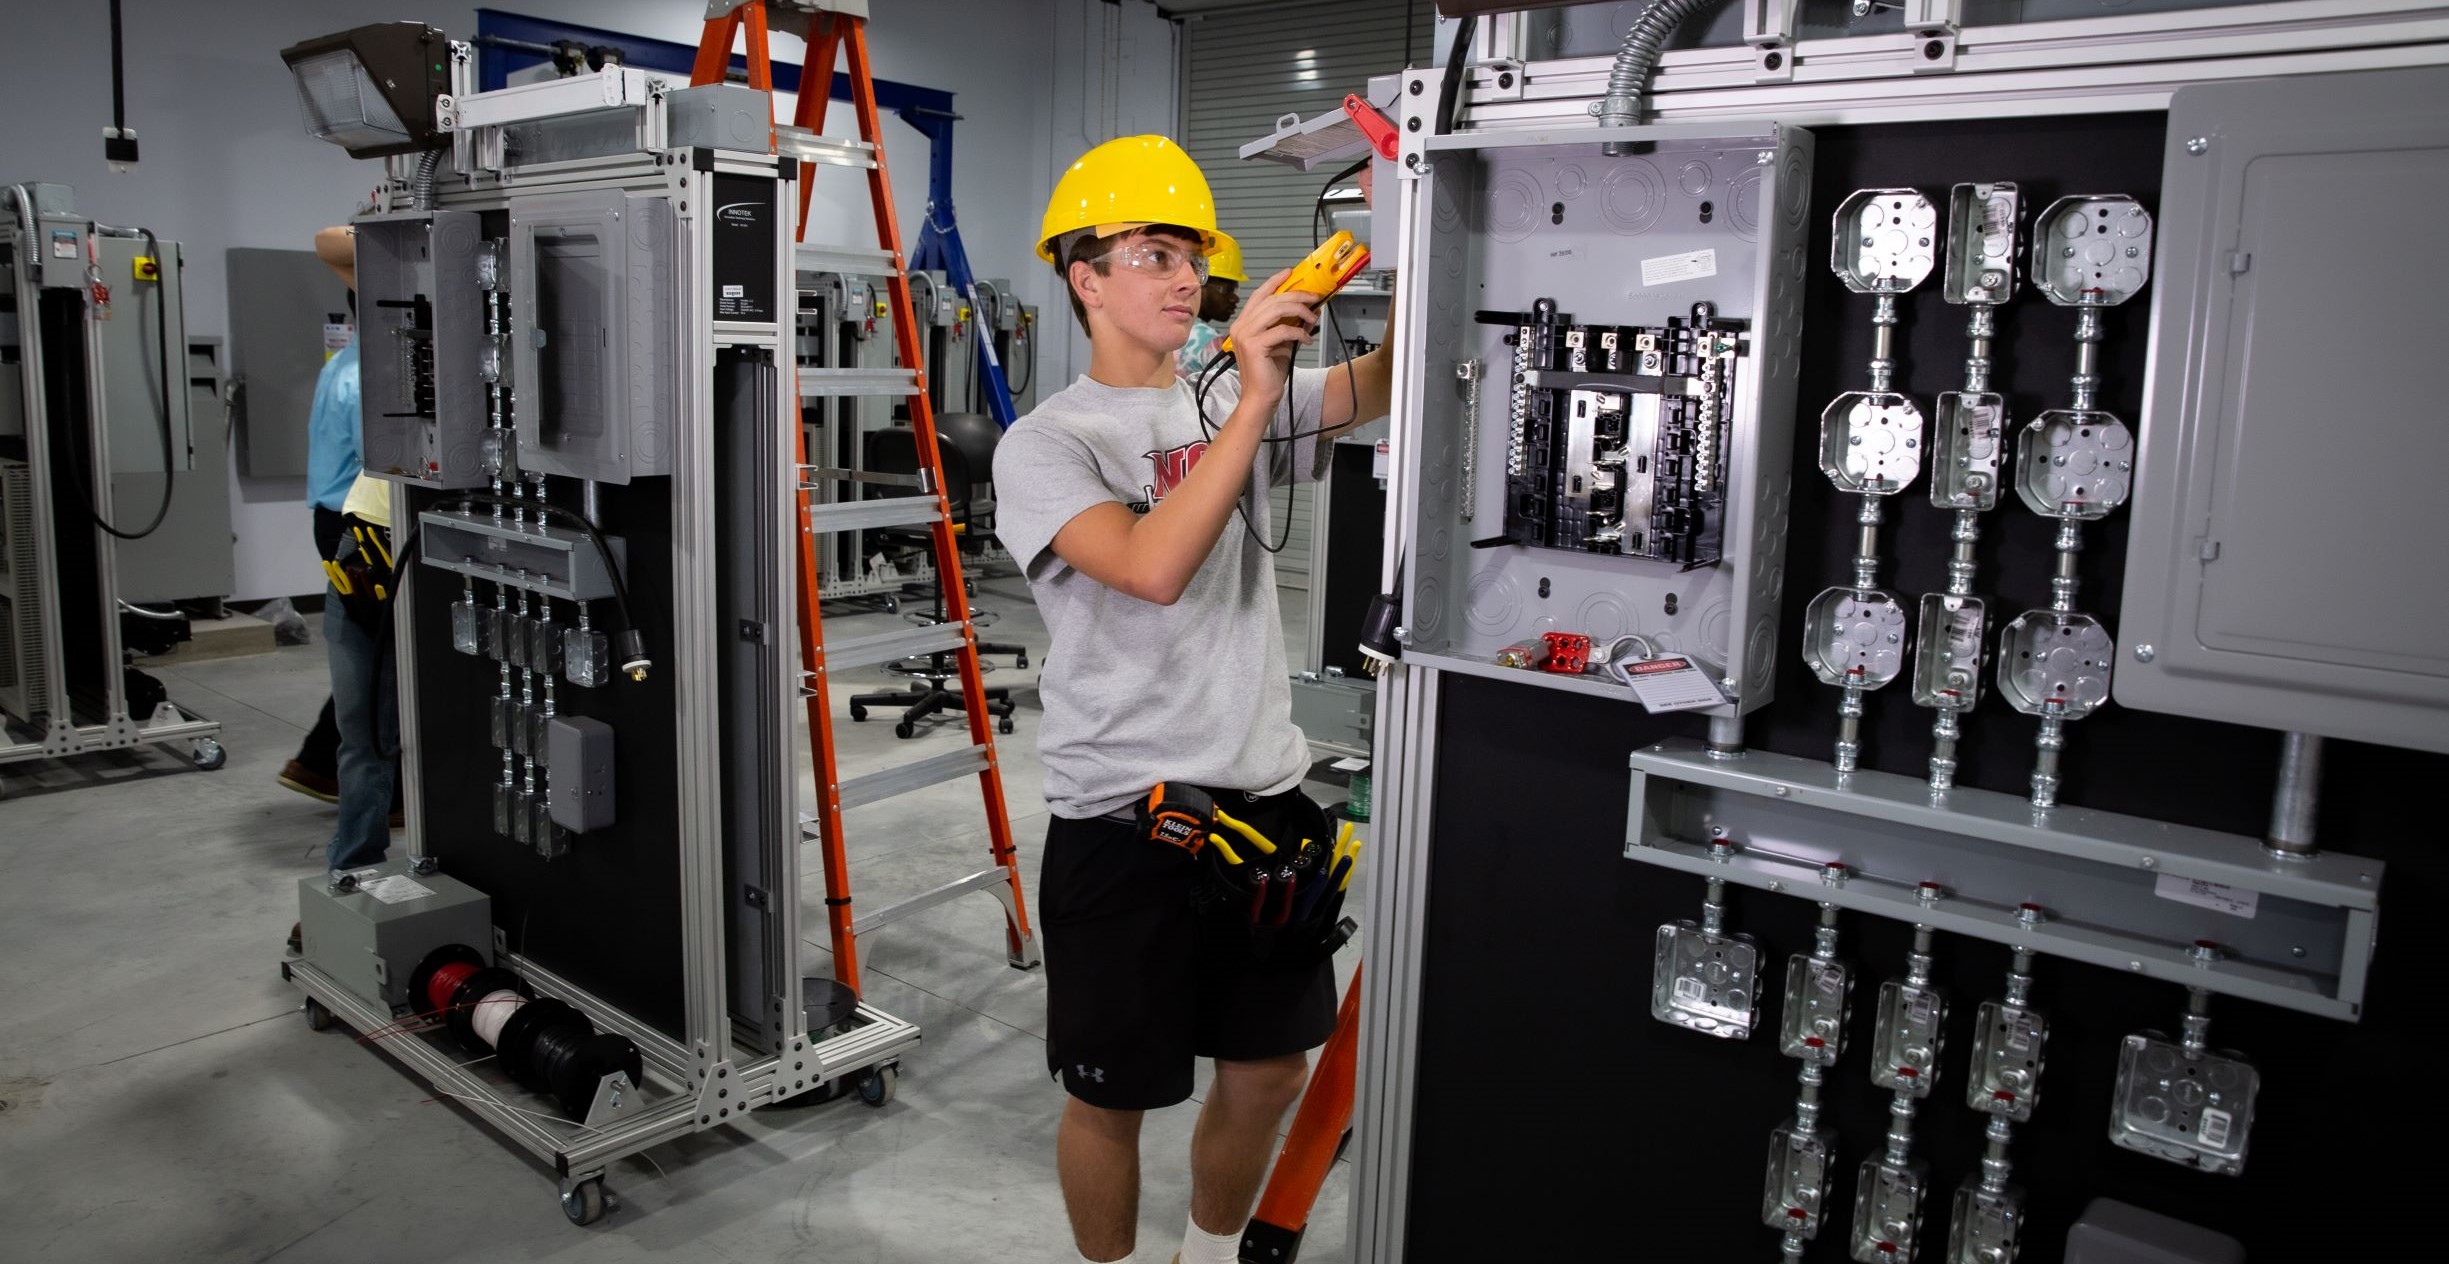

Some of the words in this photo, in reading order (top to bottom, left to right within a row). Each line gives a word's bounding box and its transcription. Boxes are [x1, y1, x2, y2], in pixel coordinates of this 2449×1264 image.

[1635, 660, 1681, 672] DANGER
[1162, 823, 1190, 836] TOOLS
[1164, 819, 1193, 831] KLEIN
